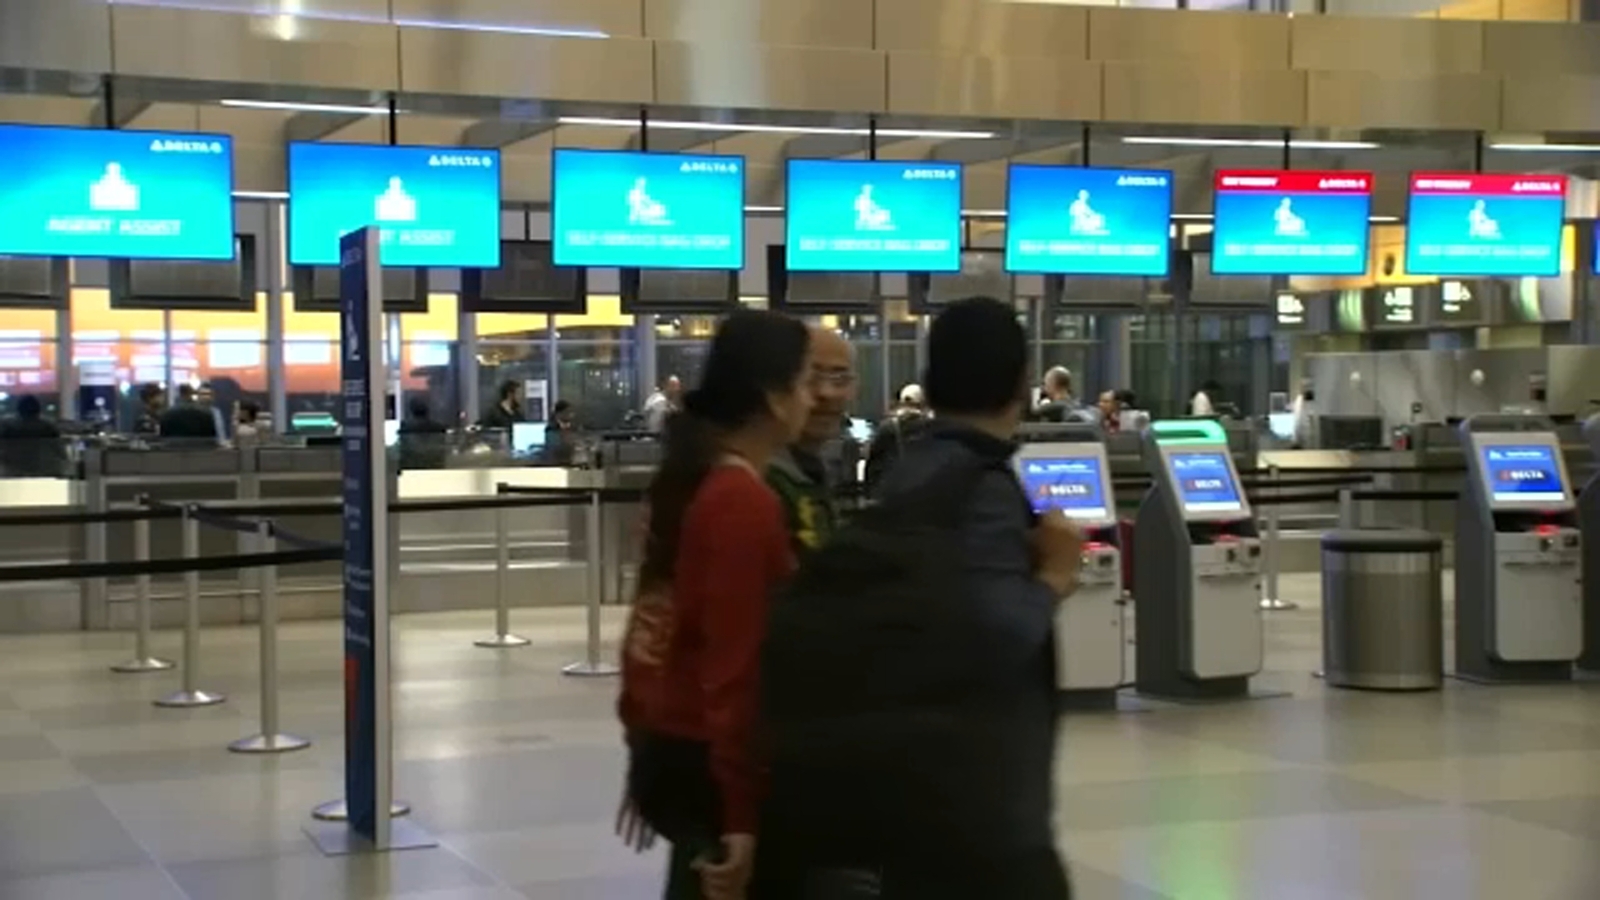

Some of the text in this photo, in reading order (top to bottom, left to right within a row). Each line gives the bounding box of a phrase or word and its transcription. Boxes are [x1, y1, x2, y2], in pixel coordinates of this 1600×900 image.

[164, 139, 210, 153] DELTA
[441, 155, 481, 167] DELTA
[692, 162, 728, 173] DELTA
[914, 169, 947, 180] DELTA
[1127, 176, 1159, 187] DELTA
[45, 217, 184, 236] AGENT ASSIST
[1510, 469, 1544, 481] DELTA
[1049, 484, 1088, 496] DELTA
